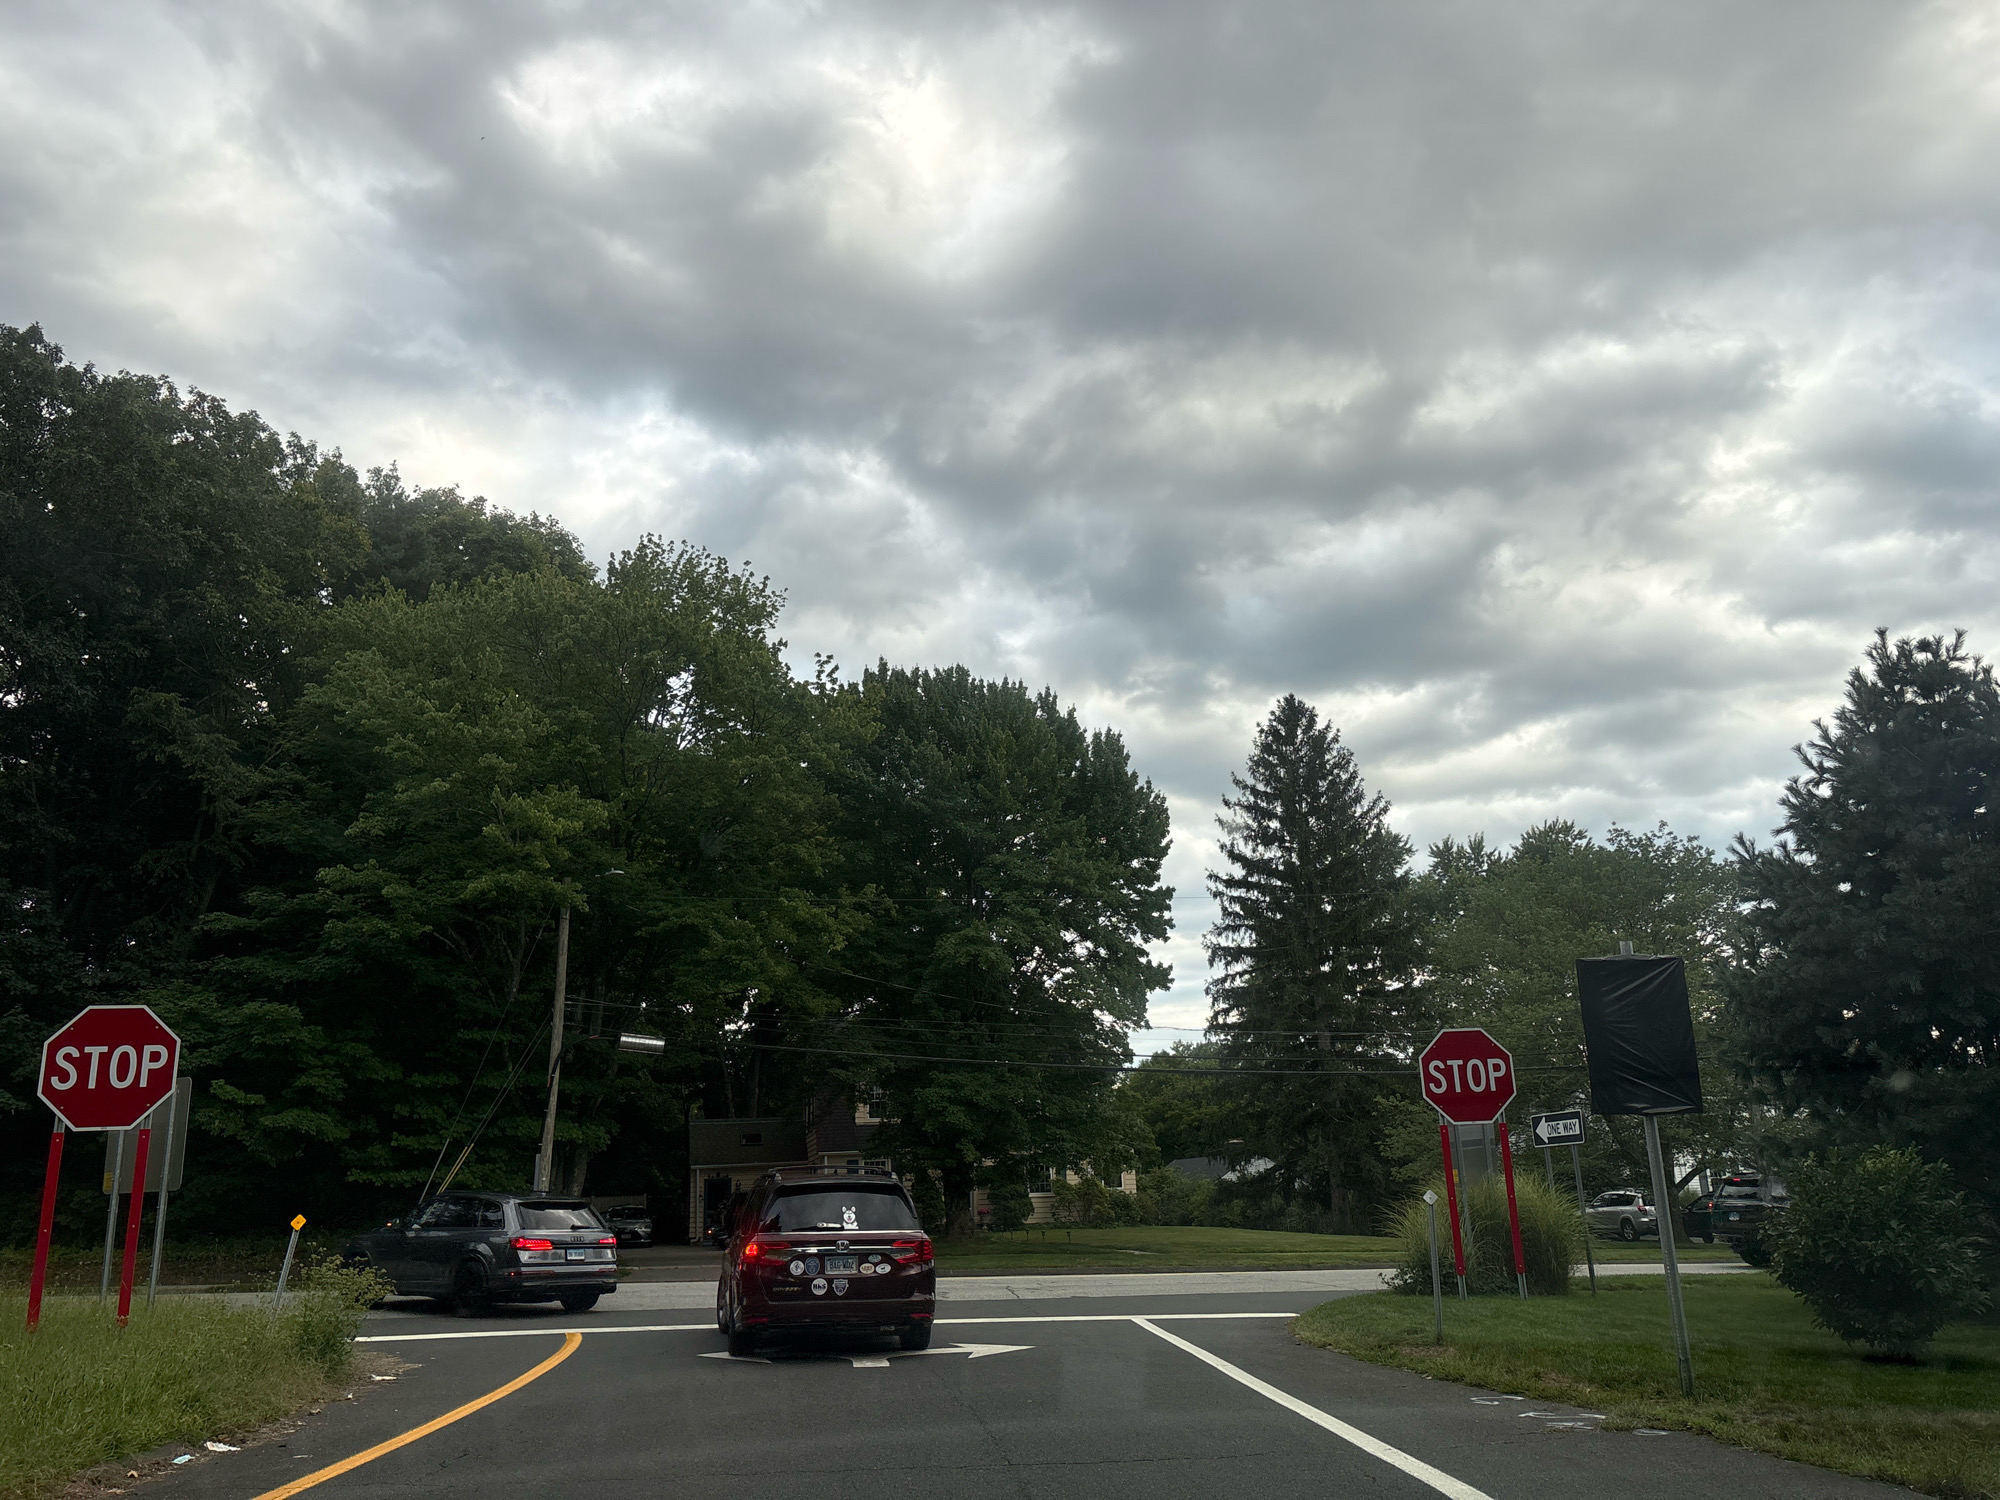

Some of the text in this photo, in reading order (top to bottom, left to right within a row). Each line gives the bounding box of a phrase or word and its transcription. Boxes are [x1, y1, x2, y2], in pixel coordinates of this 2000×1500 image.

[50, 1044, 169, 1091] STOP
[1428, 1058, 1507, 1094] STOP
[1547, 1120, 1577, 1136] ONE WAY
